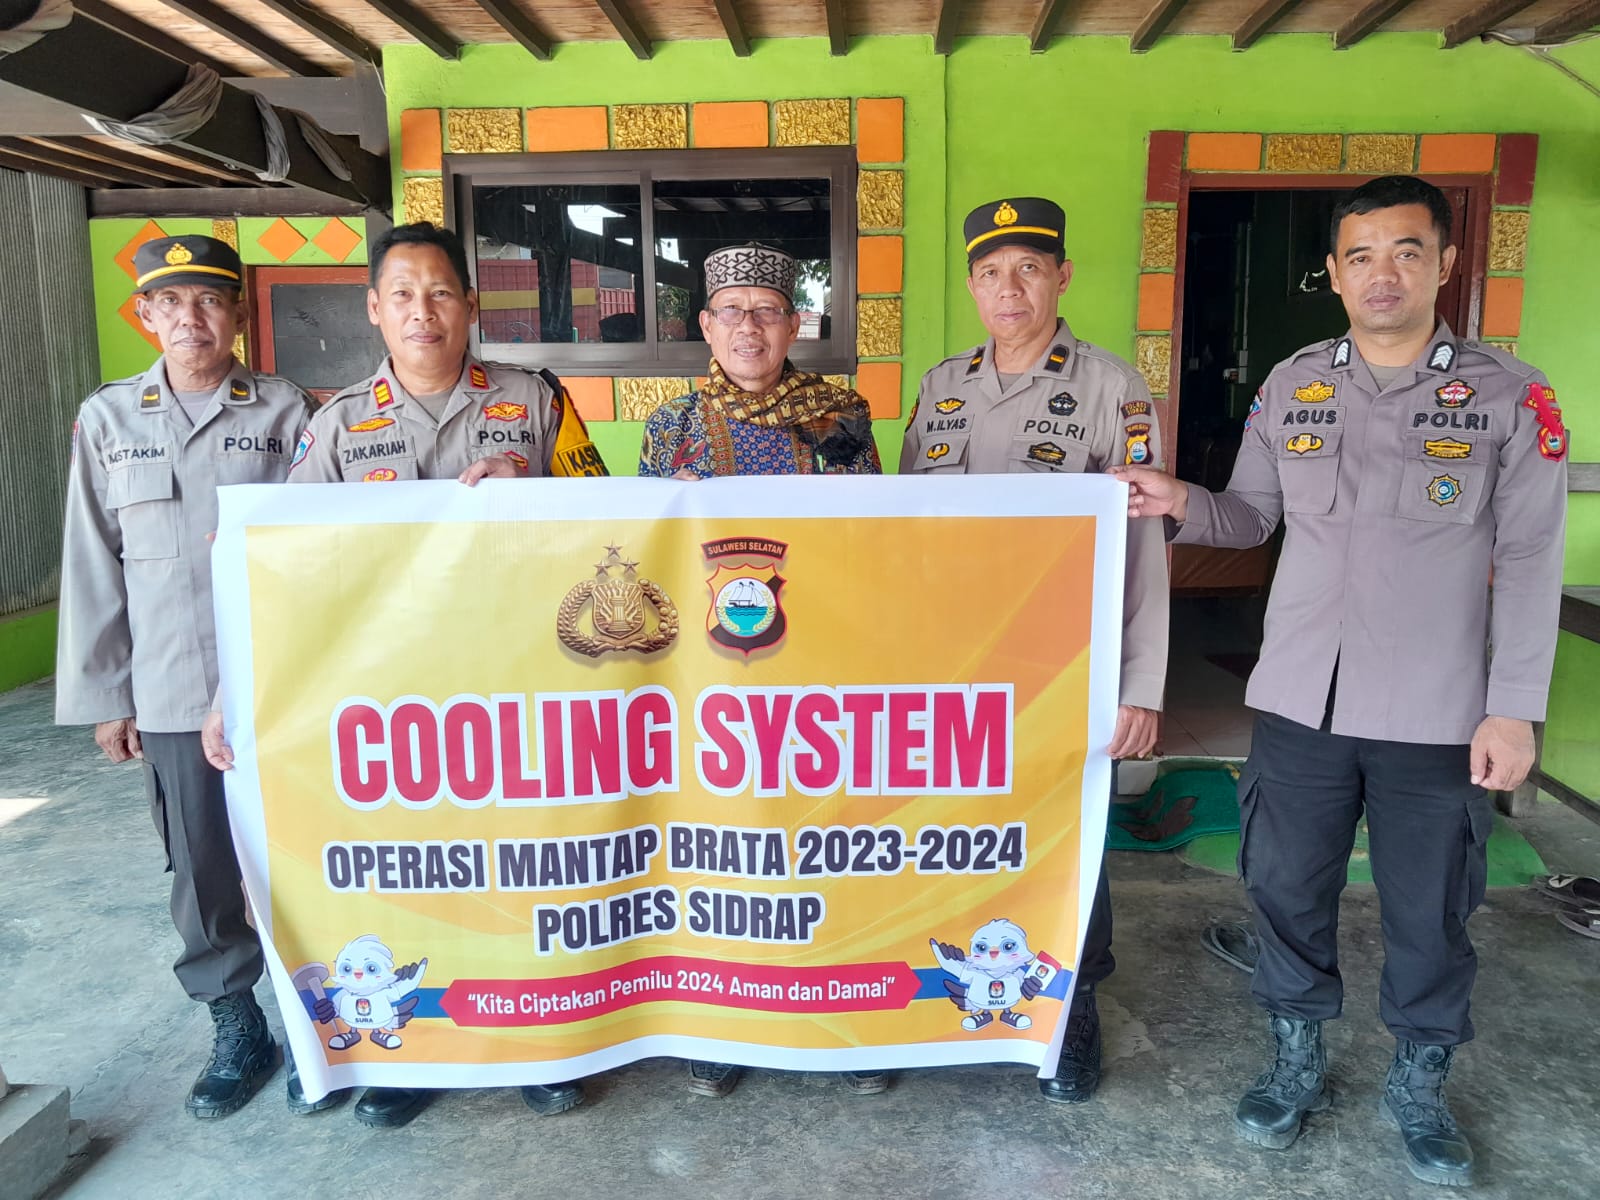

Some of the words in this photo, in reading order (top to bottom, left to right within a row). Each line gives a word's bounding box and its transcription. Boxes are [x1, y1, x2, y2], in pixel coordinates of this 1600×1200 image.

[926, 417, 968, 434] M.ILYAS
[1283, 409, 1337, 426] AGUS
[1412, 410, 1490, 431] POLRI
[478, 429, 536, 446] POLRI
[1023, 419, 1086, 441] POLRI
[224, 436, 283, 454] POLRI
[343, 439, 407, 464] ZAKARIAH
[708, 541, 747, 555] SULAWESI
[748, 541, 783, 554] SELATAN
[336, 691, 674, 804] COOLING
[700, 690, 1008, 791] SYSTEM
[326, 843, 486, 890] OPERASI
[498, 828, 658, 888] MANTAP
[670, 826, 786, 876] BRATA
[798, 826, 1024, 876] 2023-2024
[537, 888, 677, 952] POLRES
[688, 889, 821, 941] SIDRAP
[519, 989, 606, 1018] Ciptakan
[610, 970, 673, 999] Pemilu
[676, 970, 724, 993] 2024
[729, 976, 783, 1000] Aman
[787, 981, 823, 1001] dan
